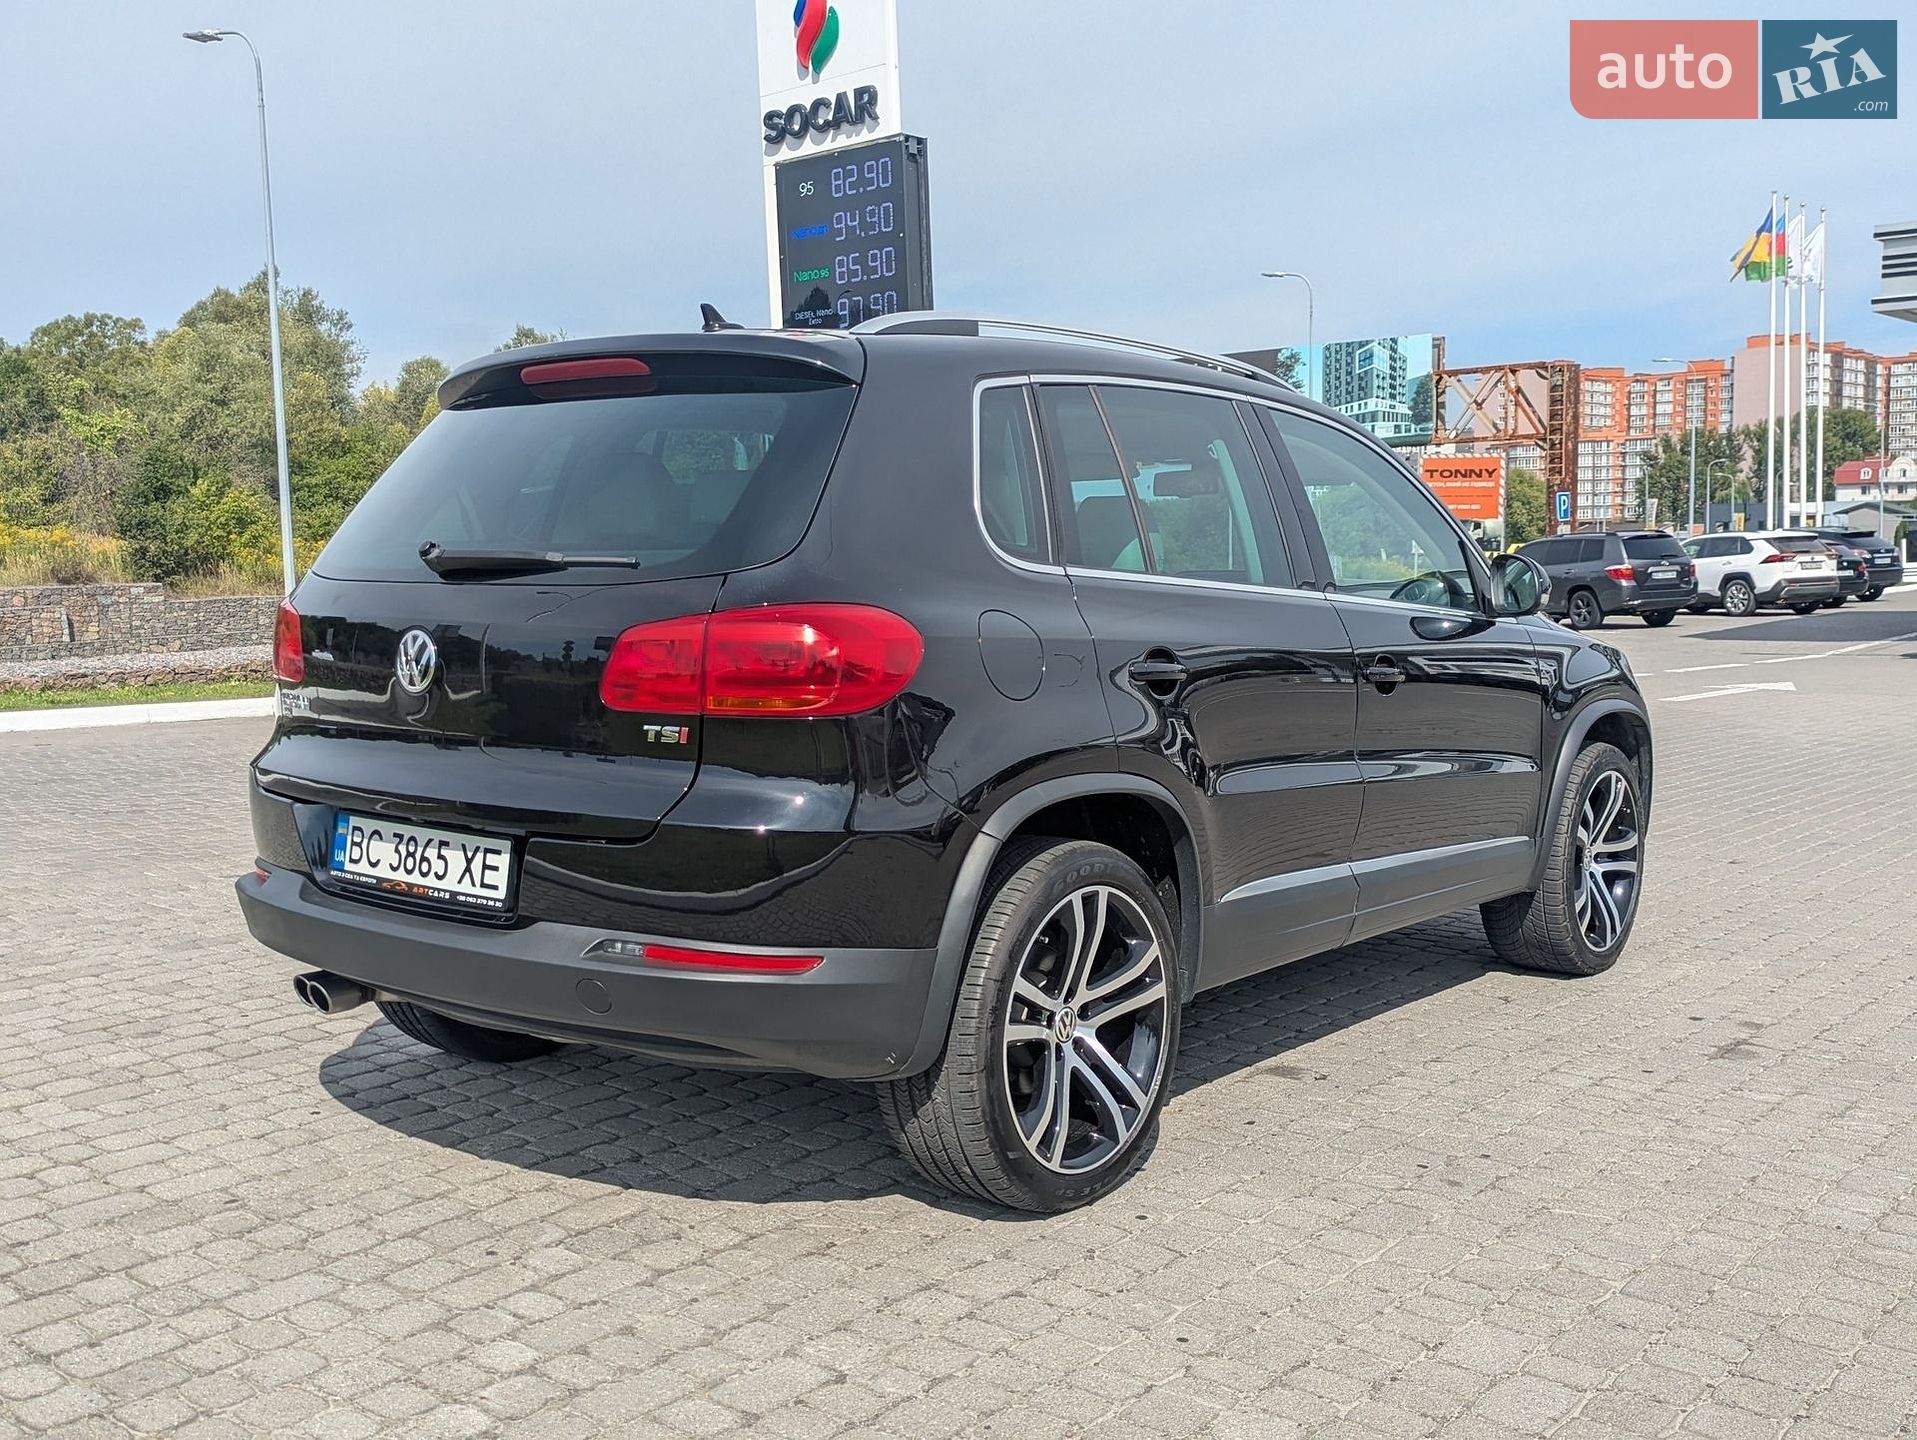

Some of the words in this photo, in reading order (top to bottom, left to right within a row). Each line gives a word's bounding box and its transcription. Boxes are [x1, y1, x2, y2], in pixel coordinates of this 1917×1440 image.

[763, 84, 880, 145] SOCAR
[799, 181, 814, 196] 95
[831, 157, 892, 198] 82.90
[833, 202, 893, 241] 94.90
[835, 247, 896, 285] 85.90
[837, 290, 897, 329] 9790
[1425, 468, 1498, 478] TONNY
[1561, 499, 1568, 517] P
[643, 725, 689, 744] TSI
[334, 848, 346, 862] UA
[349, 825, 384, 869] BC
[388, 832, 450, 881] 3865
[457, 843, 503, 891] XE
